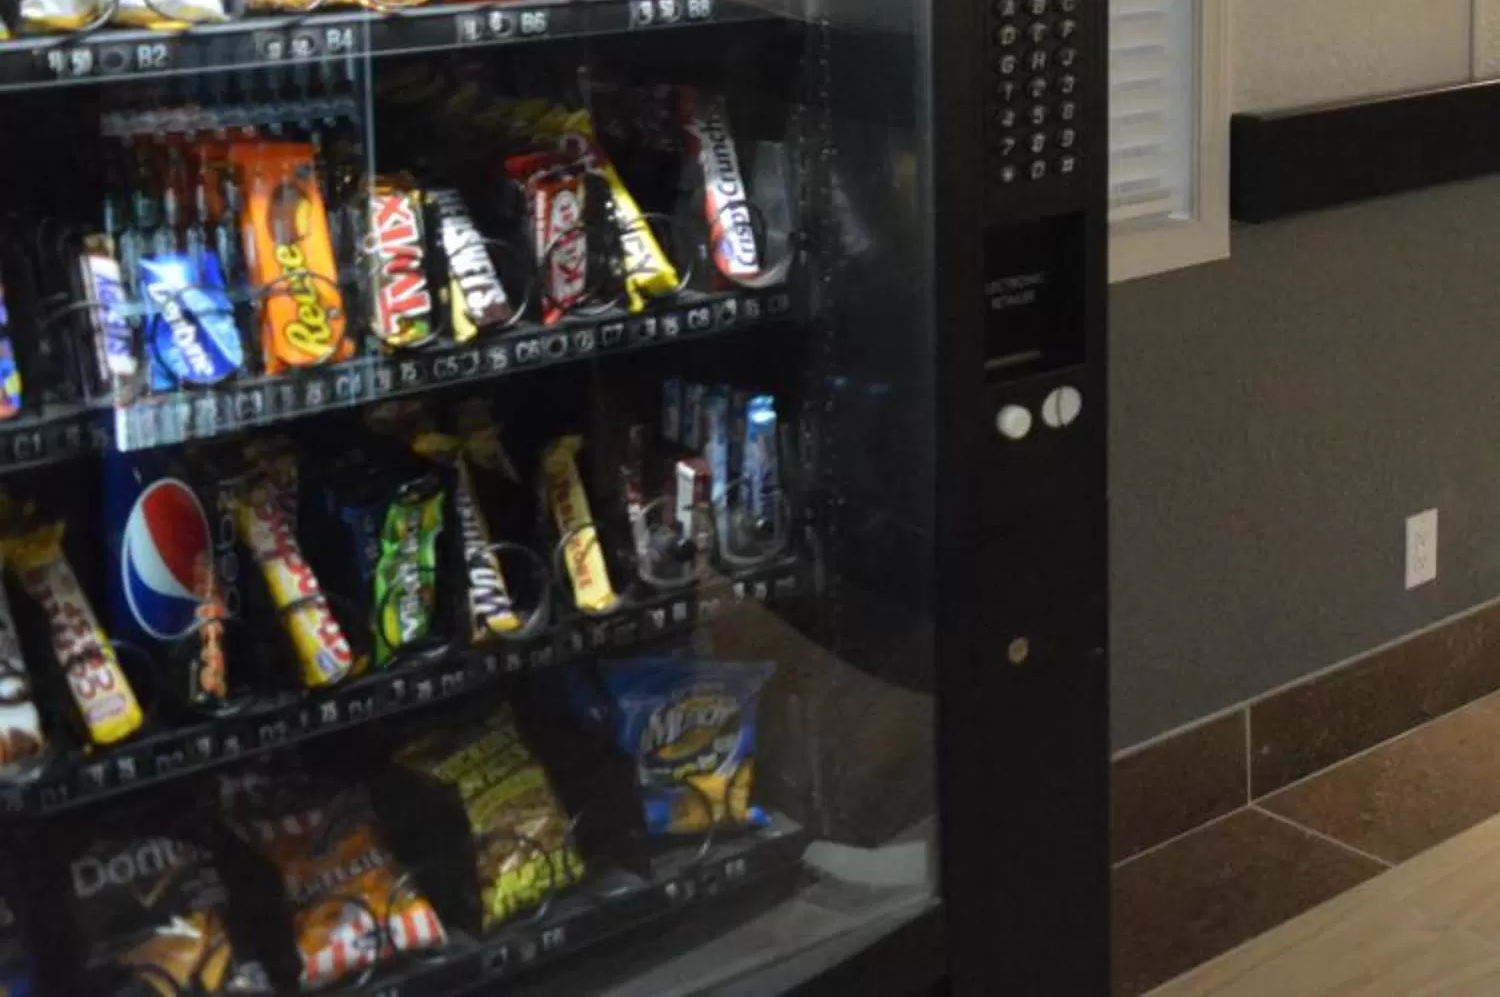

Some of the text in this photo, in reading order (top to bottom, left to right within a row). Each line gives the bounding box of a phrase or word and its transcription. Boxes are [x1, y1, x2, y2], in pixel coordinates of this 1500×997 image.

[137, 44, 167, 70] B2
[327, 30, 354, 51] B4
[700, 119, 737, 196] Crunch
[371, 194, 432, 332] TWIX
[434, 359, 457, 377] C5
[70, 835, 212, 897] Dorit
